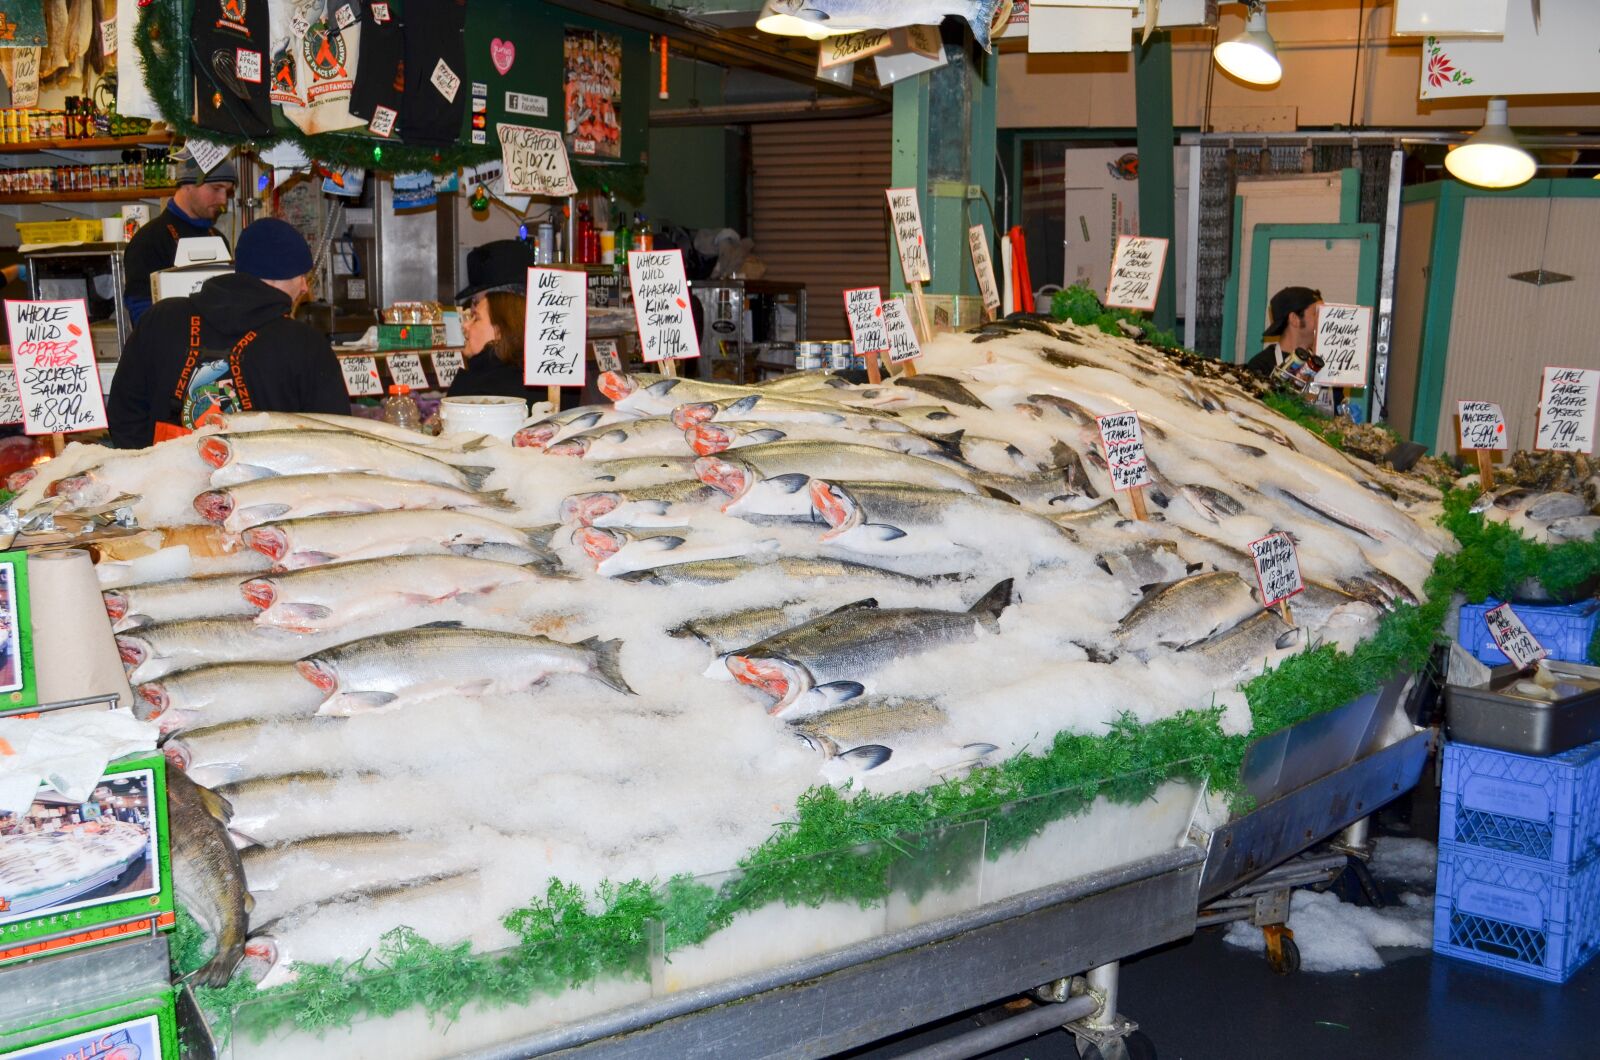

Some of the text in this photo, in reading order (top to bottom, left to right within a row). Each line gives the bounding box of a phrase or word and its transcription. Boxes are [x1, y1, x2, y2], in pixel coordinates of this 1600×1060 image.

[521, 102, 545, 113] Facebook
[502, 127, 520, 146] OUR
[521, 129, 561, 150] SEAFOOD
[512, 151, 557, 170] IS 100%
[637, 254, 672, 269] WHOLE
[538, 271, 562, 288] WE
[600, 275, 618, 287] fish?
[642, 269, 664, 281] WILD
[1114, 267, 1153, 280] MUSSELS
[638, 280, 680, 299] ALASKAN
[850, 290, 874, 302] WHOLE
[537, 290, 578, 307] FILLET
[645, 299, 670, 313] KING
[18, 303, 72, 325] WHOLE
[539, 310, 570, 325] THE
[647, 310, 683, 326] SALMON
[1326, 307, 1358, 320] LIVE!
[26, 324, 61, 342] WILD
[539, 325, 571, 342] FISH
[1321, 321, 1360, 336] MANILA
[18, 340, 78, 357] COPPER
[1324, 334, 1358, 348] CLAMS
[543, 343, 565, 358] FOR
[34, 354, 77, 368] RIVER
[537, 353, 578, 376] FREE!
[24, 365, 92, 384] SOCKEYE
[1551, 369, 1585, 383] LIVE!
[32, 380, 87, 396] SALMON
[1551, 383, 1590, 395] LARGE
[1463, 402, 1491, 411] WHOLE
[1548, 393, 1587, 407] PACIFIC
[183, 400, 192, 421] PIKE
[1547, 406, 1586, 420] OYSTERS
[1127, 416, 1136, 425] TO
[1462, 413, 1501, 424] MACKEREL
[1105, 425, 1136, 441] TRAVEL!
[1113, 468, 1123, 481] 48
[0, 911, 81, 935] SOCKEYE
[4, 916, 164, 958] KED SALMON
[60, 1033, 113, 1060] BLIC
